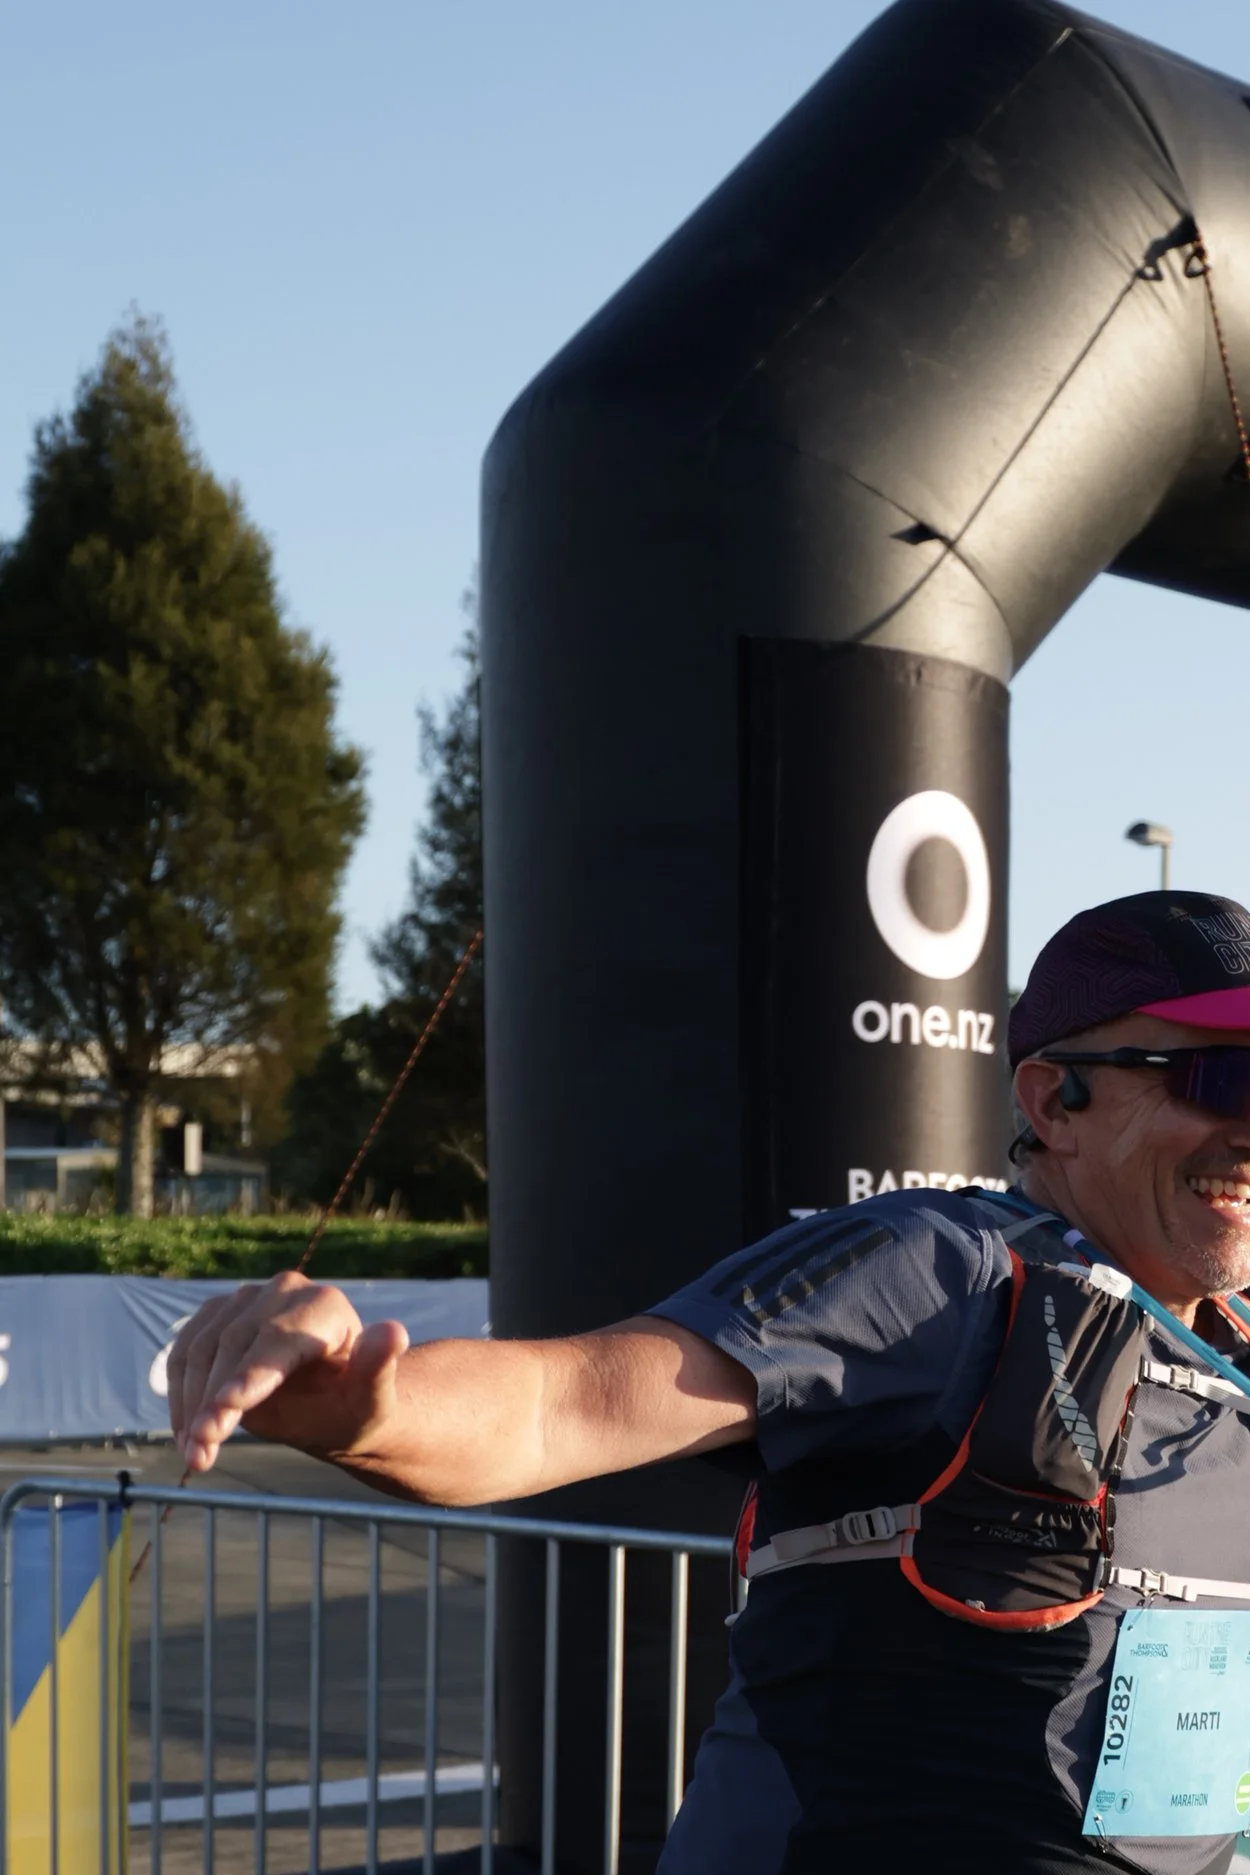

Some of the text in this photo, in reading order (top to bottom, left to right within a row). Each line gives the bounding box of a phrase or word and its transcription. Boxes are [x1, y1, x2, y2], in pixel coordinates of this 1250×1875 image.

[852, 1000, 995, 1055] one.nz
[1103, 1675, 1134, 1766] 10282
[1176, 1711, 1221, 1731] MARTI
[1170, 1793, 1209, 1807] MARATHON
